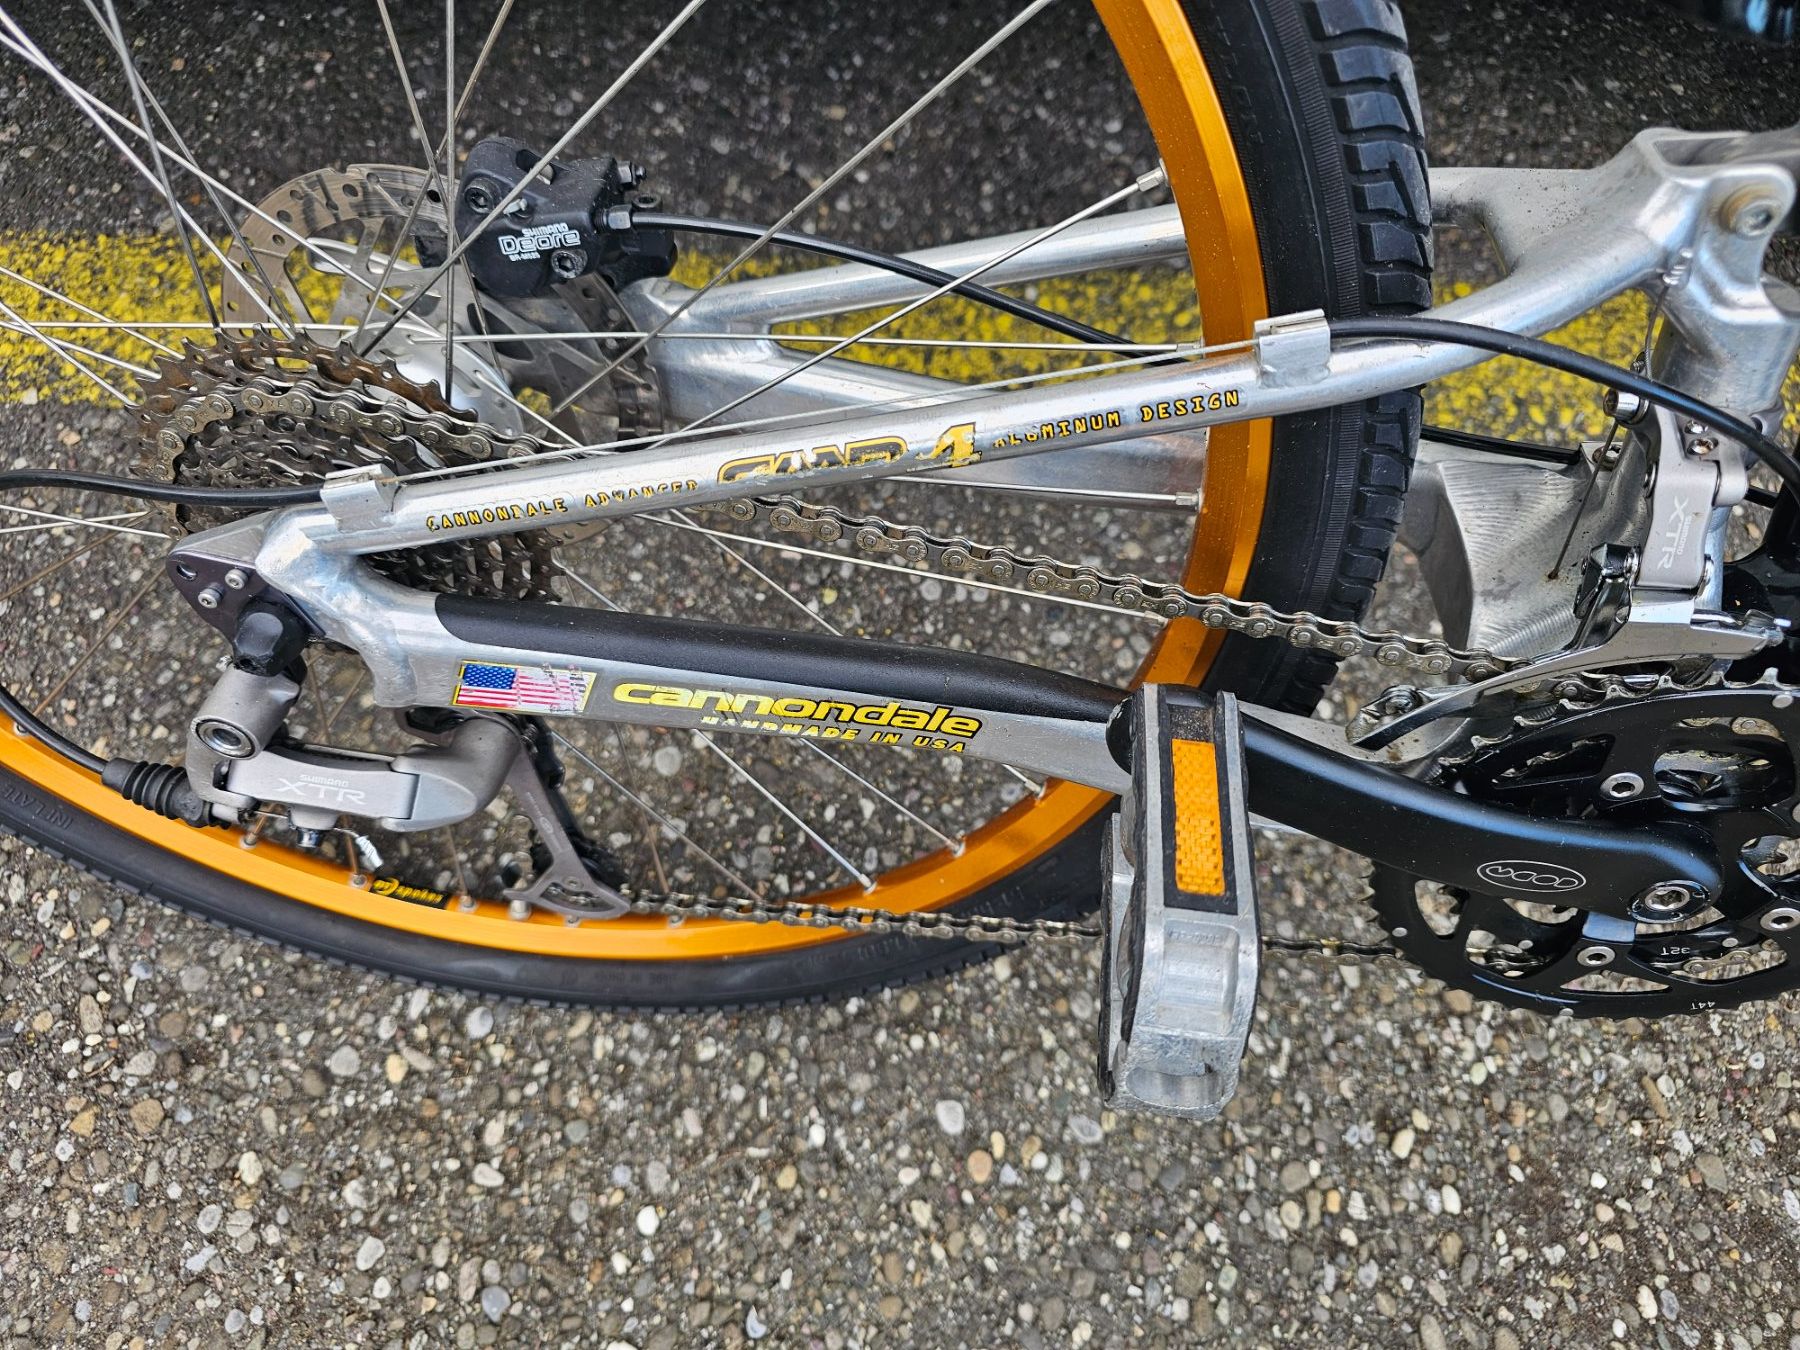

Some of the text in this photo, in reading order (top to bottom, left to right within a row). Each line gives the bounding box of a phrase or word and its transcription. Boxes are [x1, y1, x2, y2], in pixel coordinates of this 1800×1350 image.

[498, 229, 582, 255] Deore
[522, 222, 569, 237] SHIMANO
[1140, 389, 1239, 423] DESIGN
[613, 681, 983, 739] cannondale
[701, 715, 967, 753] HANDMADE IN USA
[276, 777, 367, 805] XTR
[299, 774, 350, 787] SHIMANO
[1660, 946, 1691, 956] 32T
[1691, 1000, 1716, 1010] 44T
